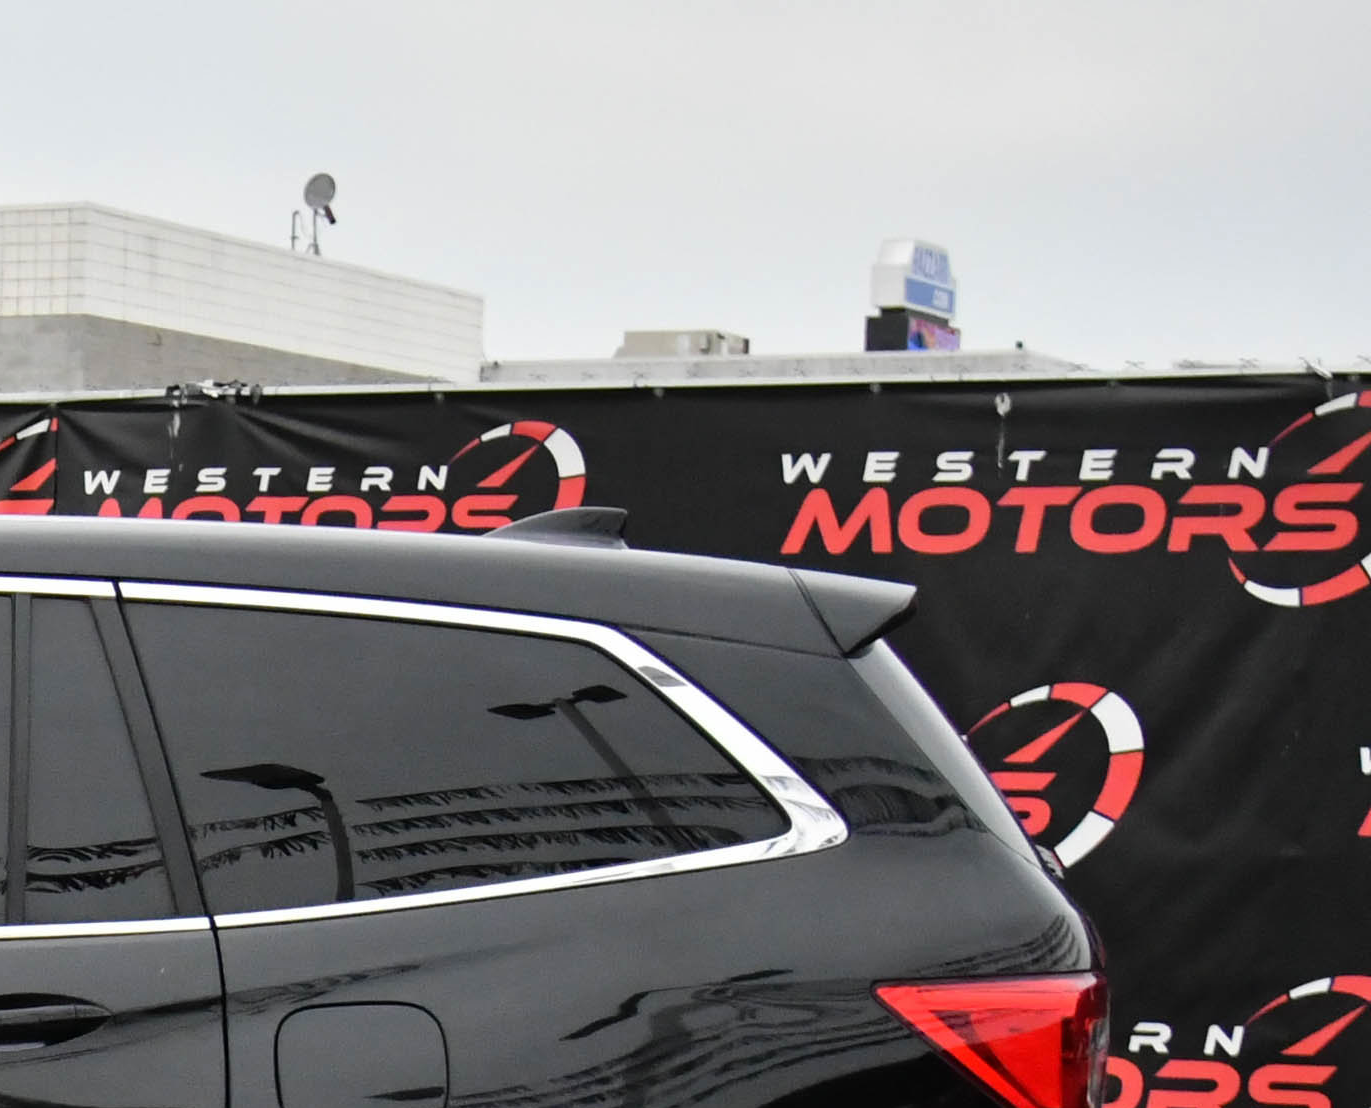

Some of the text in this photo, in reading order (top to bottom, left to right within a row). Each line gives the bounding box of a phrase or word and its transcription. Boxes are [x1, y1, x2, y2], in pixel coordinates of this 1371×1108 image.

[84, 465, 448, 494] WESTERN
[781, 448, 1269, 484] WESTERN
[780, 483, 1363, 554] MOTORS
